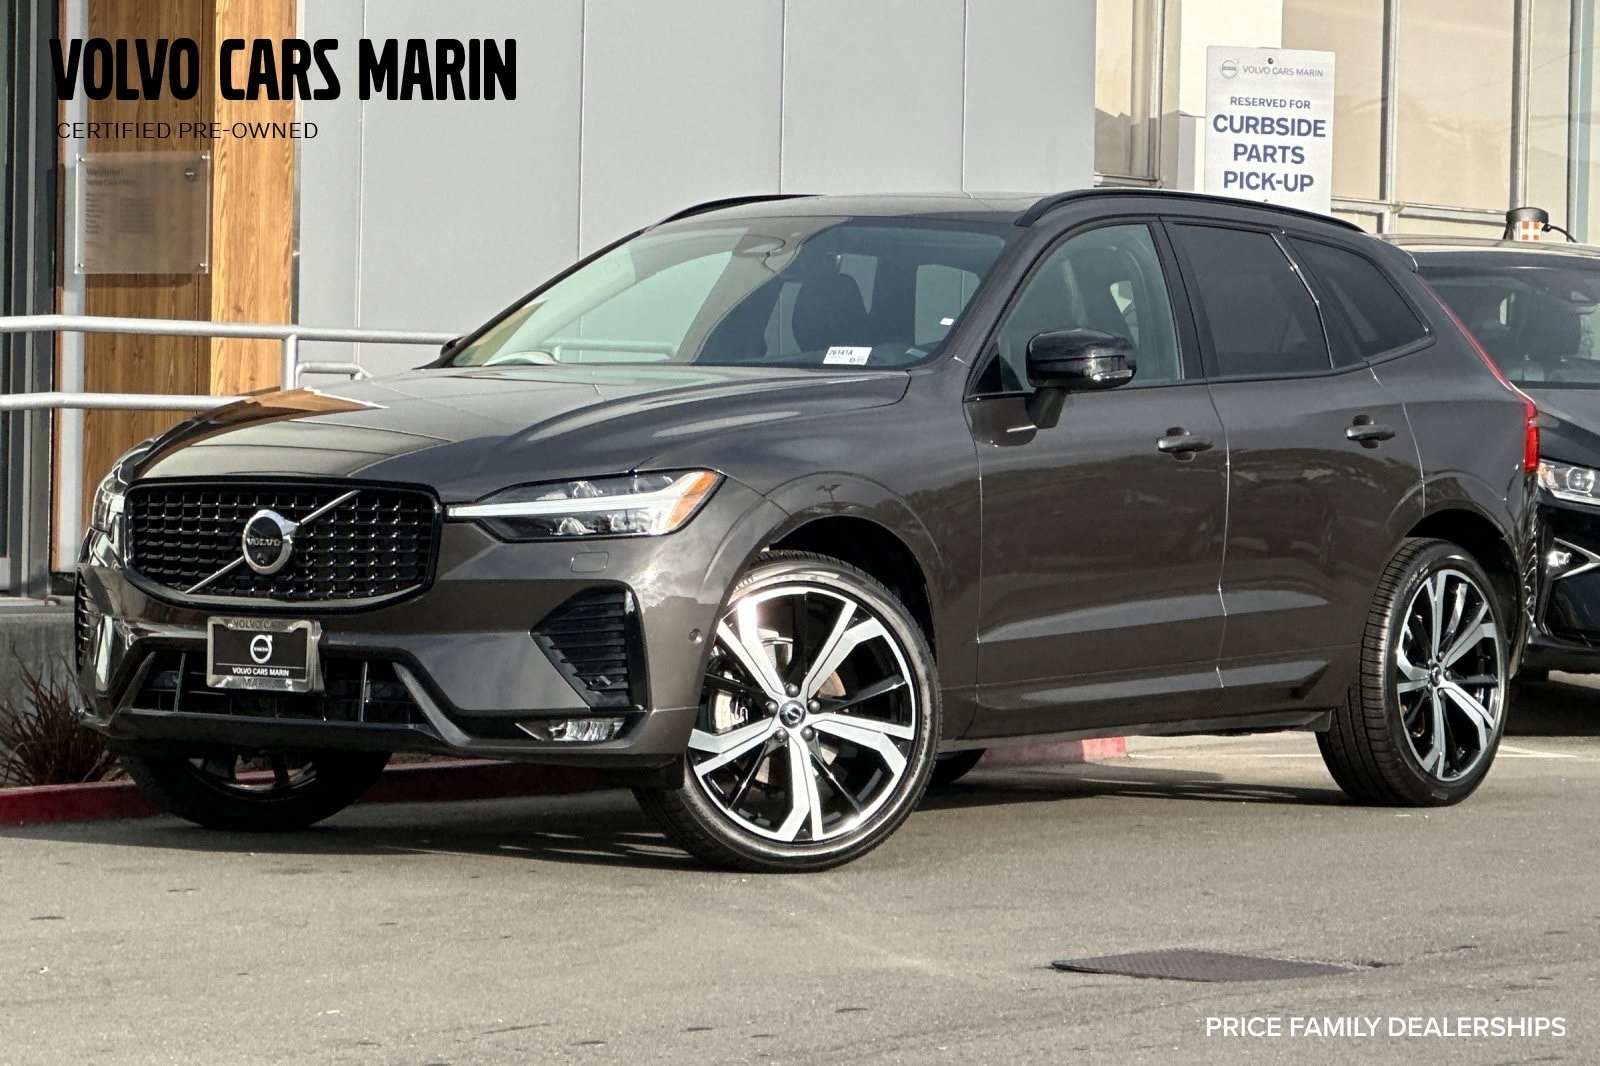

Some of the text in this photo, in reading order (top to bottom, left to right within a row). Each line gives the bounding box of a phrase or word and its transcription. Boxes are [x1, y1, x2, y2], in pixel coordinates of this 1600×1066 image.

[1243, 65, 1271, 75] VOLVO
[1272, 67, 1295, 76] CARS
[1296, 68, 1324, 77] MARIN
[1230, 96, 1311, 109] RESERVED FOR
[1212, 113, 1326, 138] CURBSIDE
[1233, 143, 1306, 165] PARTS
[1223, 170, 1315, 193] PICK-UP
[246, 538, 282, 547] VOLVO
[233, 619, 262, 629] VOLVO
[232, 666, 290, 677] VOLVO CARS MARIN
